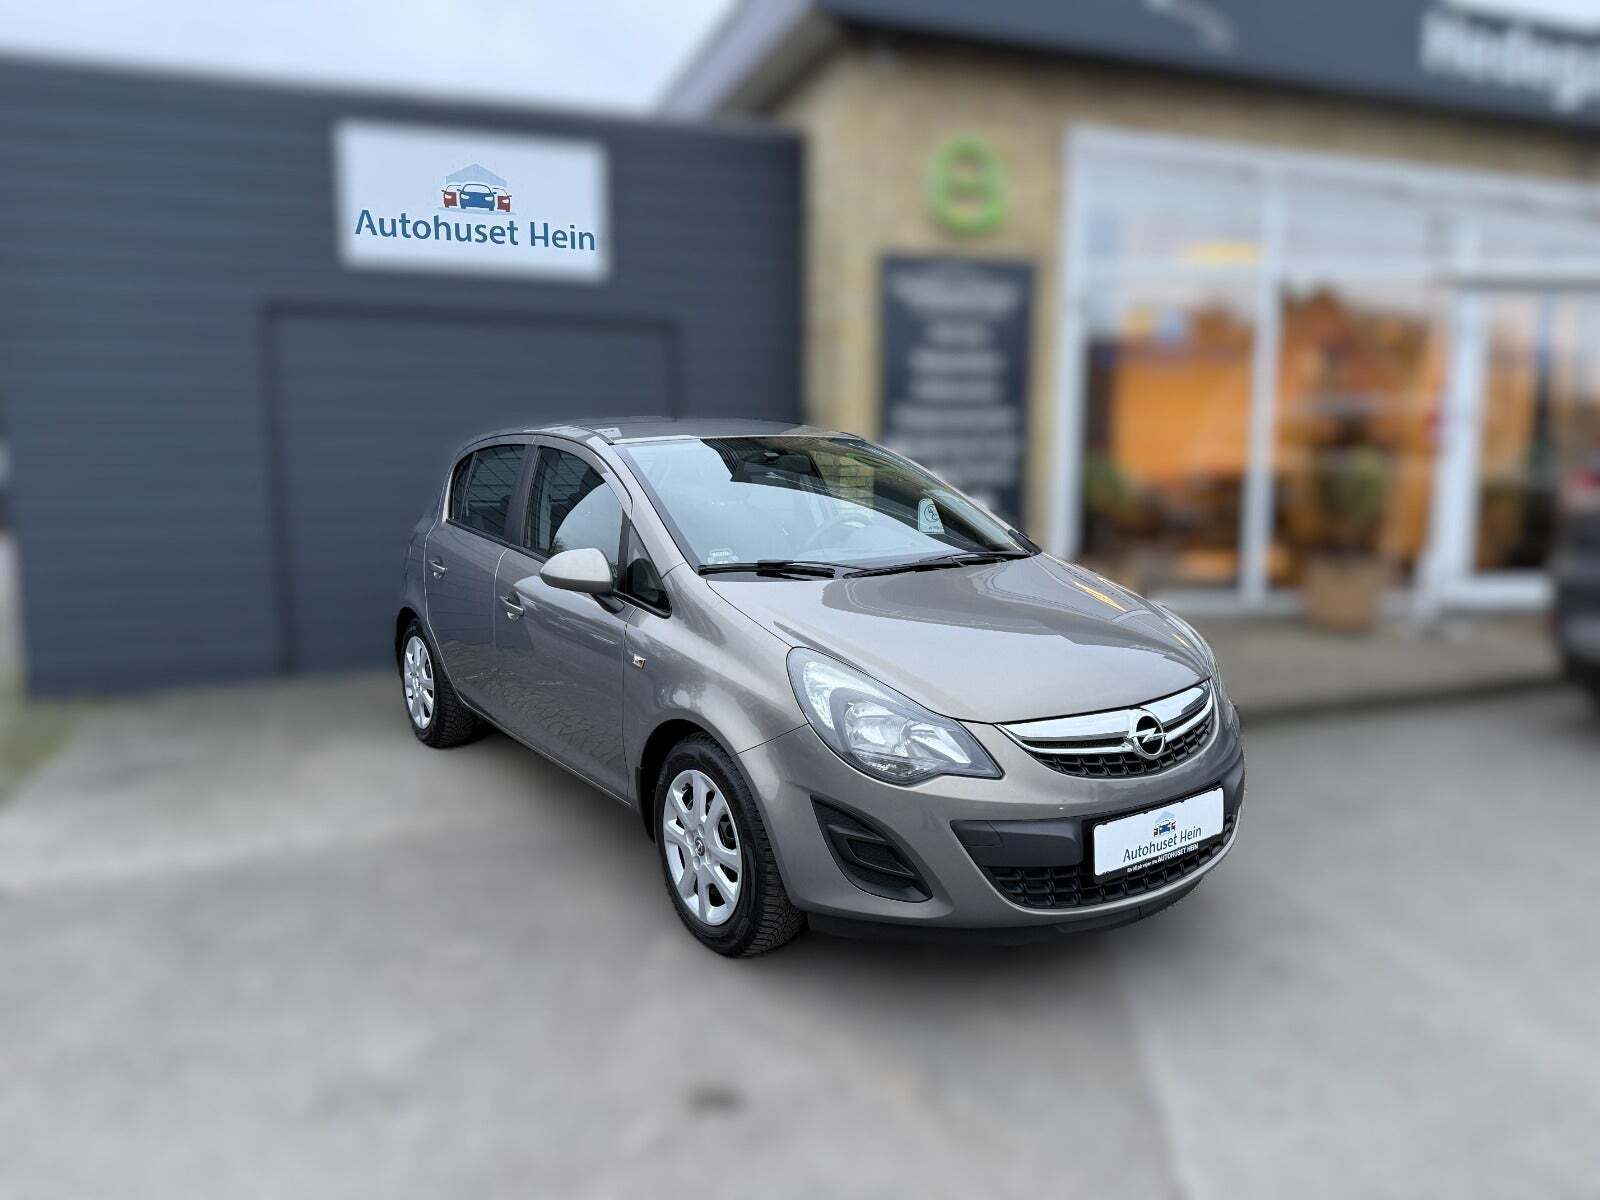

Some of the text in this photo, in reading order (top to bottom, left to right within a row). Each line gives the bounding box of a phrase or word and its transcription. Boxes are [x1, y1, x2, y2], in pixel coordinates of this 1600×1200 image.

[354, 209, 595, 251] Autohuset Hein
[1123, 826, 1202, 863] Autohuset Hein
[1157, 847, 1186, 863] AUTOHUSET
